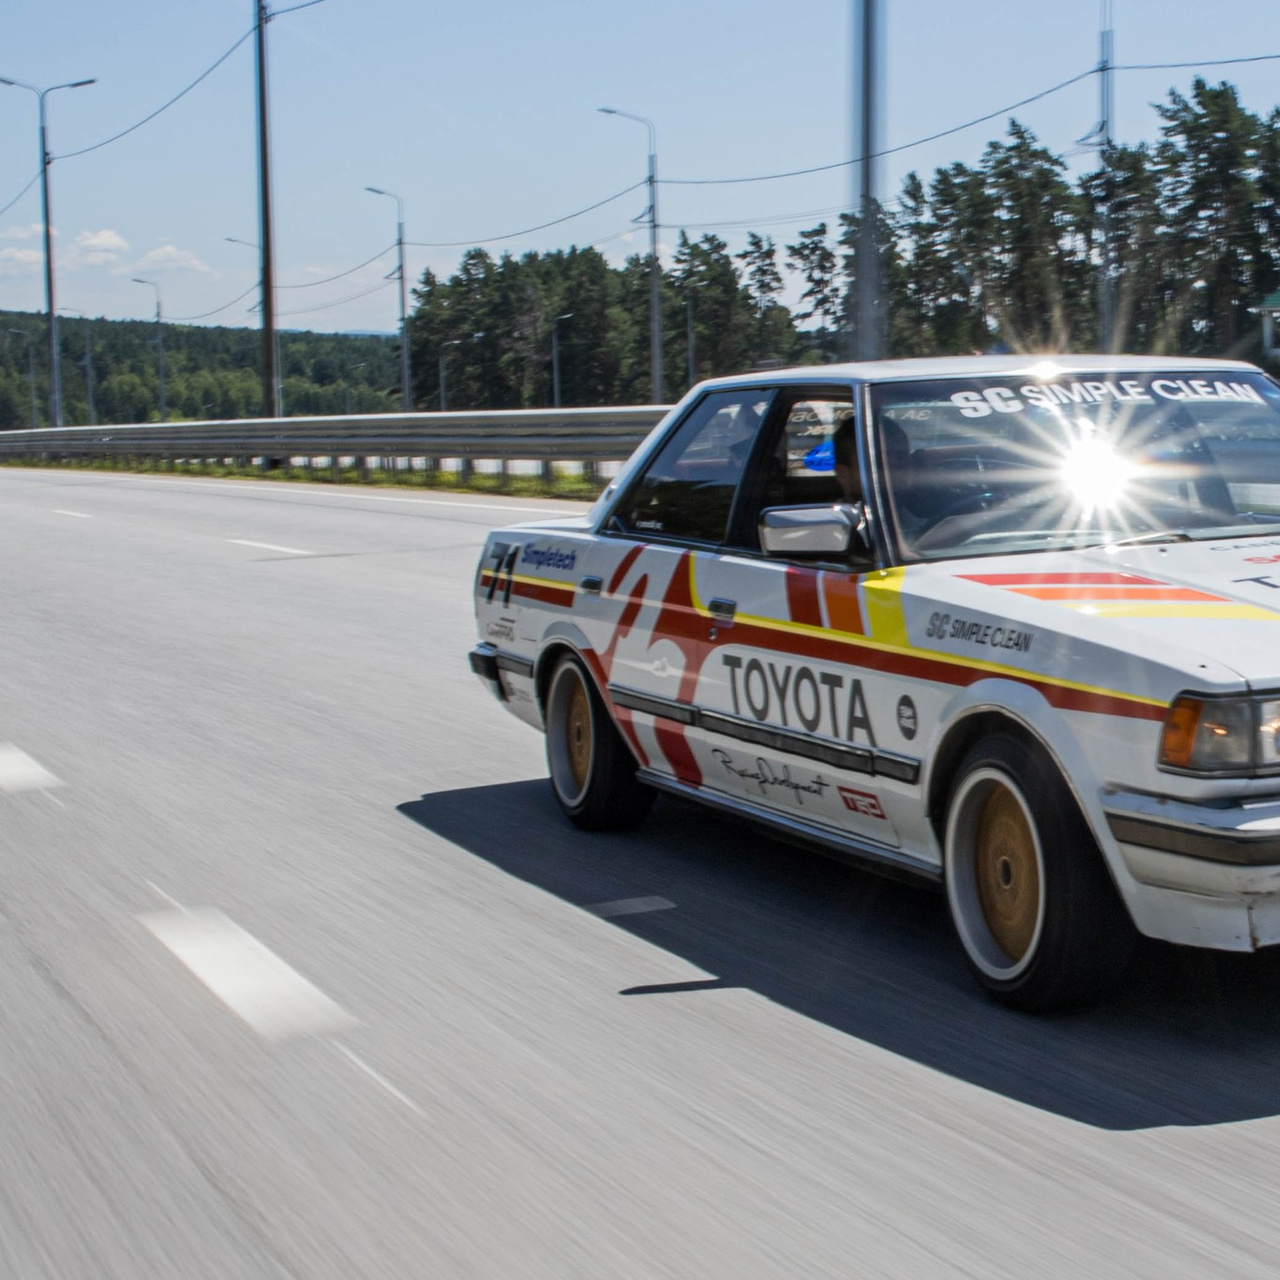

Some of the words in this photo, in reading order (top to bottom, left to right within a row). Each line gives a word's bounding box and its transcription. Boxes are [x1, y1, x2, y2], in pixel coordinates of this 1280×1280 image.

[951, 386, 1025, 419] SC
[1019, 379, 1157, 407] SIMPLE
[1152, 379, 1268, 405] CLEAN
[521, 542, 578, 571] Simpletech
[949, 619, 992, 645] SIMPLE
[990, 627, 1034, 653] CLEAN
[722, 653, 878, 749] TOYOTA
